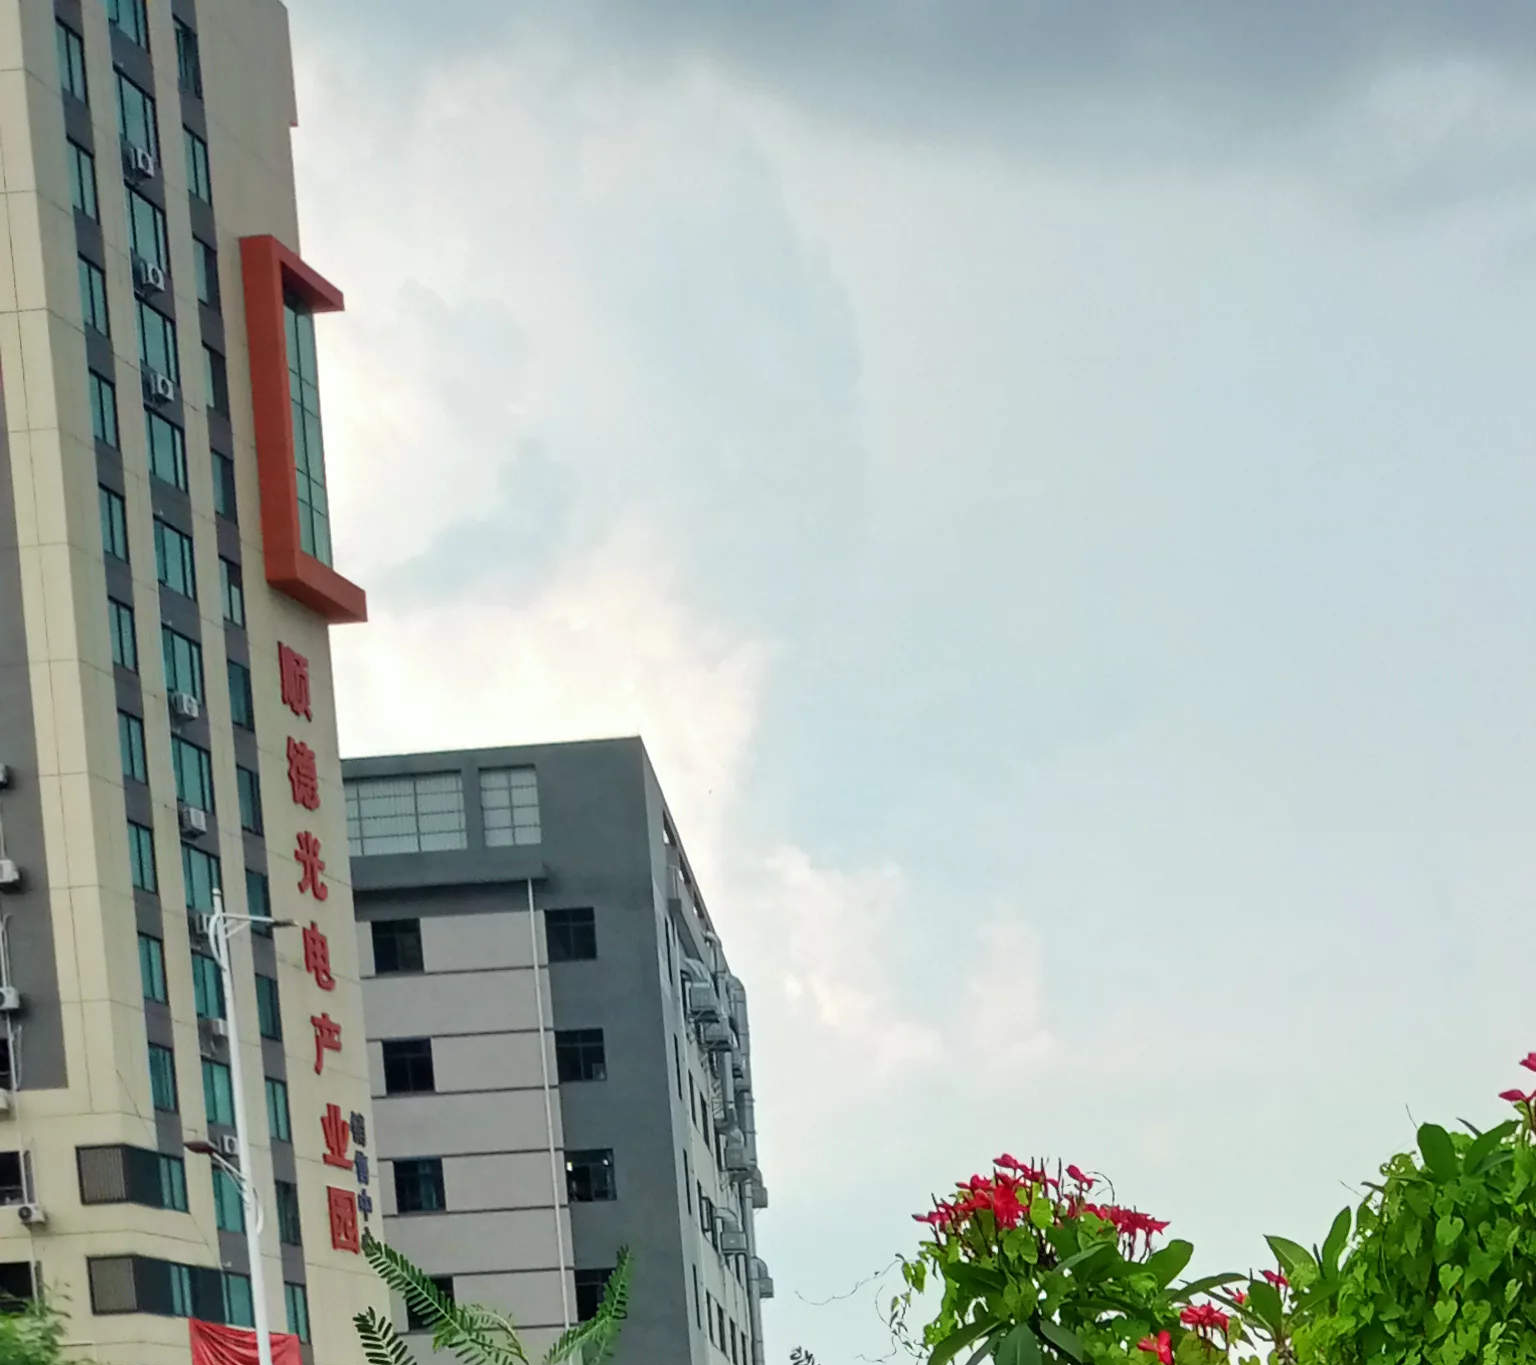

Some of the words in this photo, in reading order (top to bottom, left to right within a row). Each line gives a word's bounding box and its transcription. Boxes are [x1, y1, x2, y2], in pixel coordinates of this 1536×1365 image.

[277, 640, 361, 1255] 顺德光电产业园
